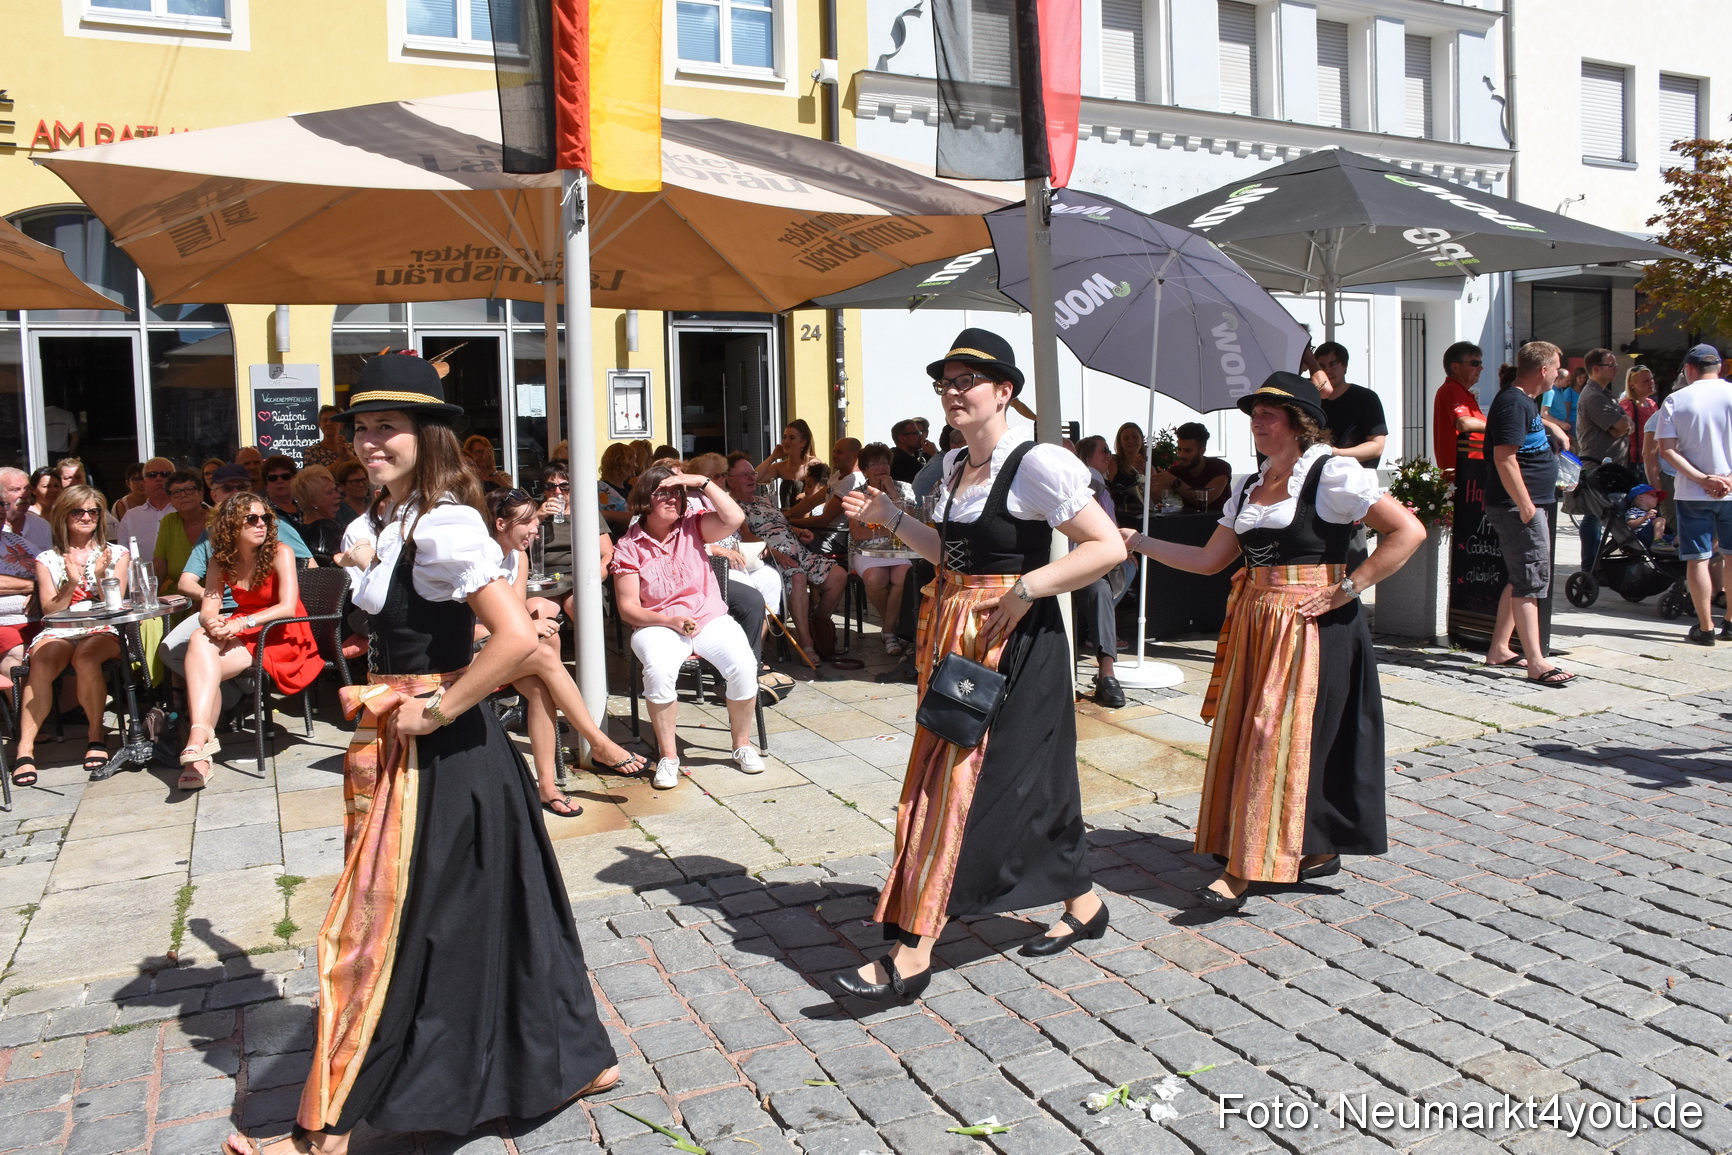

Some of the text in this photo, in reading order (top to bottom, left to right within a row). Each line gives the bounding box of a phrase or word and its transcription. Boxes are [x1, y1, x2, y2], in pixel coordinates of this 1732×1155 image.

[31, 119, 84, 150] AM
[801, 324, 822, 341] 24
[271, 410, 307, 426] Rigatoni
[283, 423, 293, 431] al
